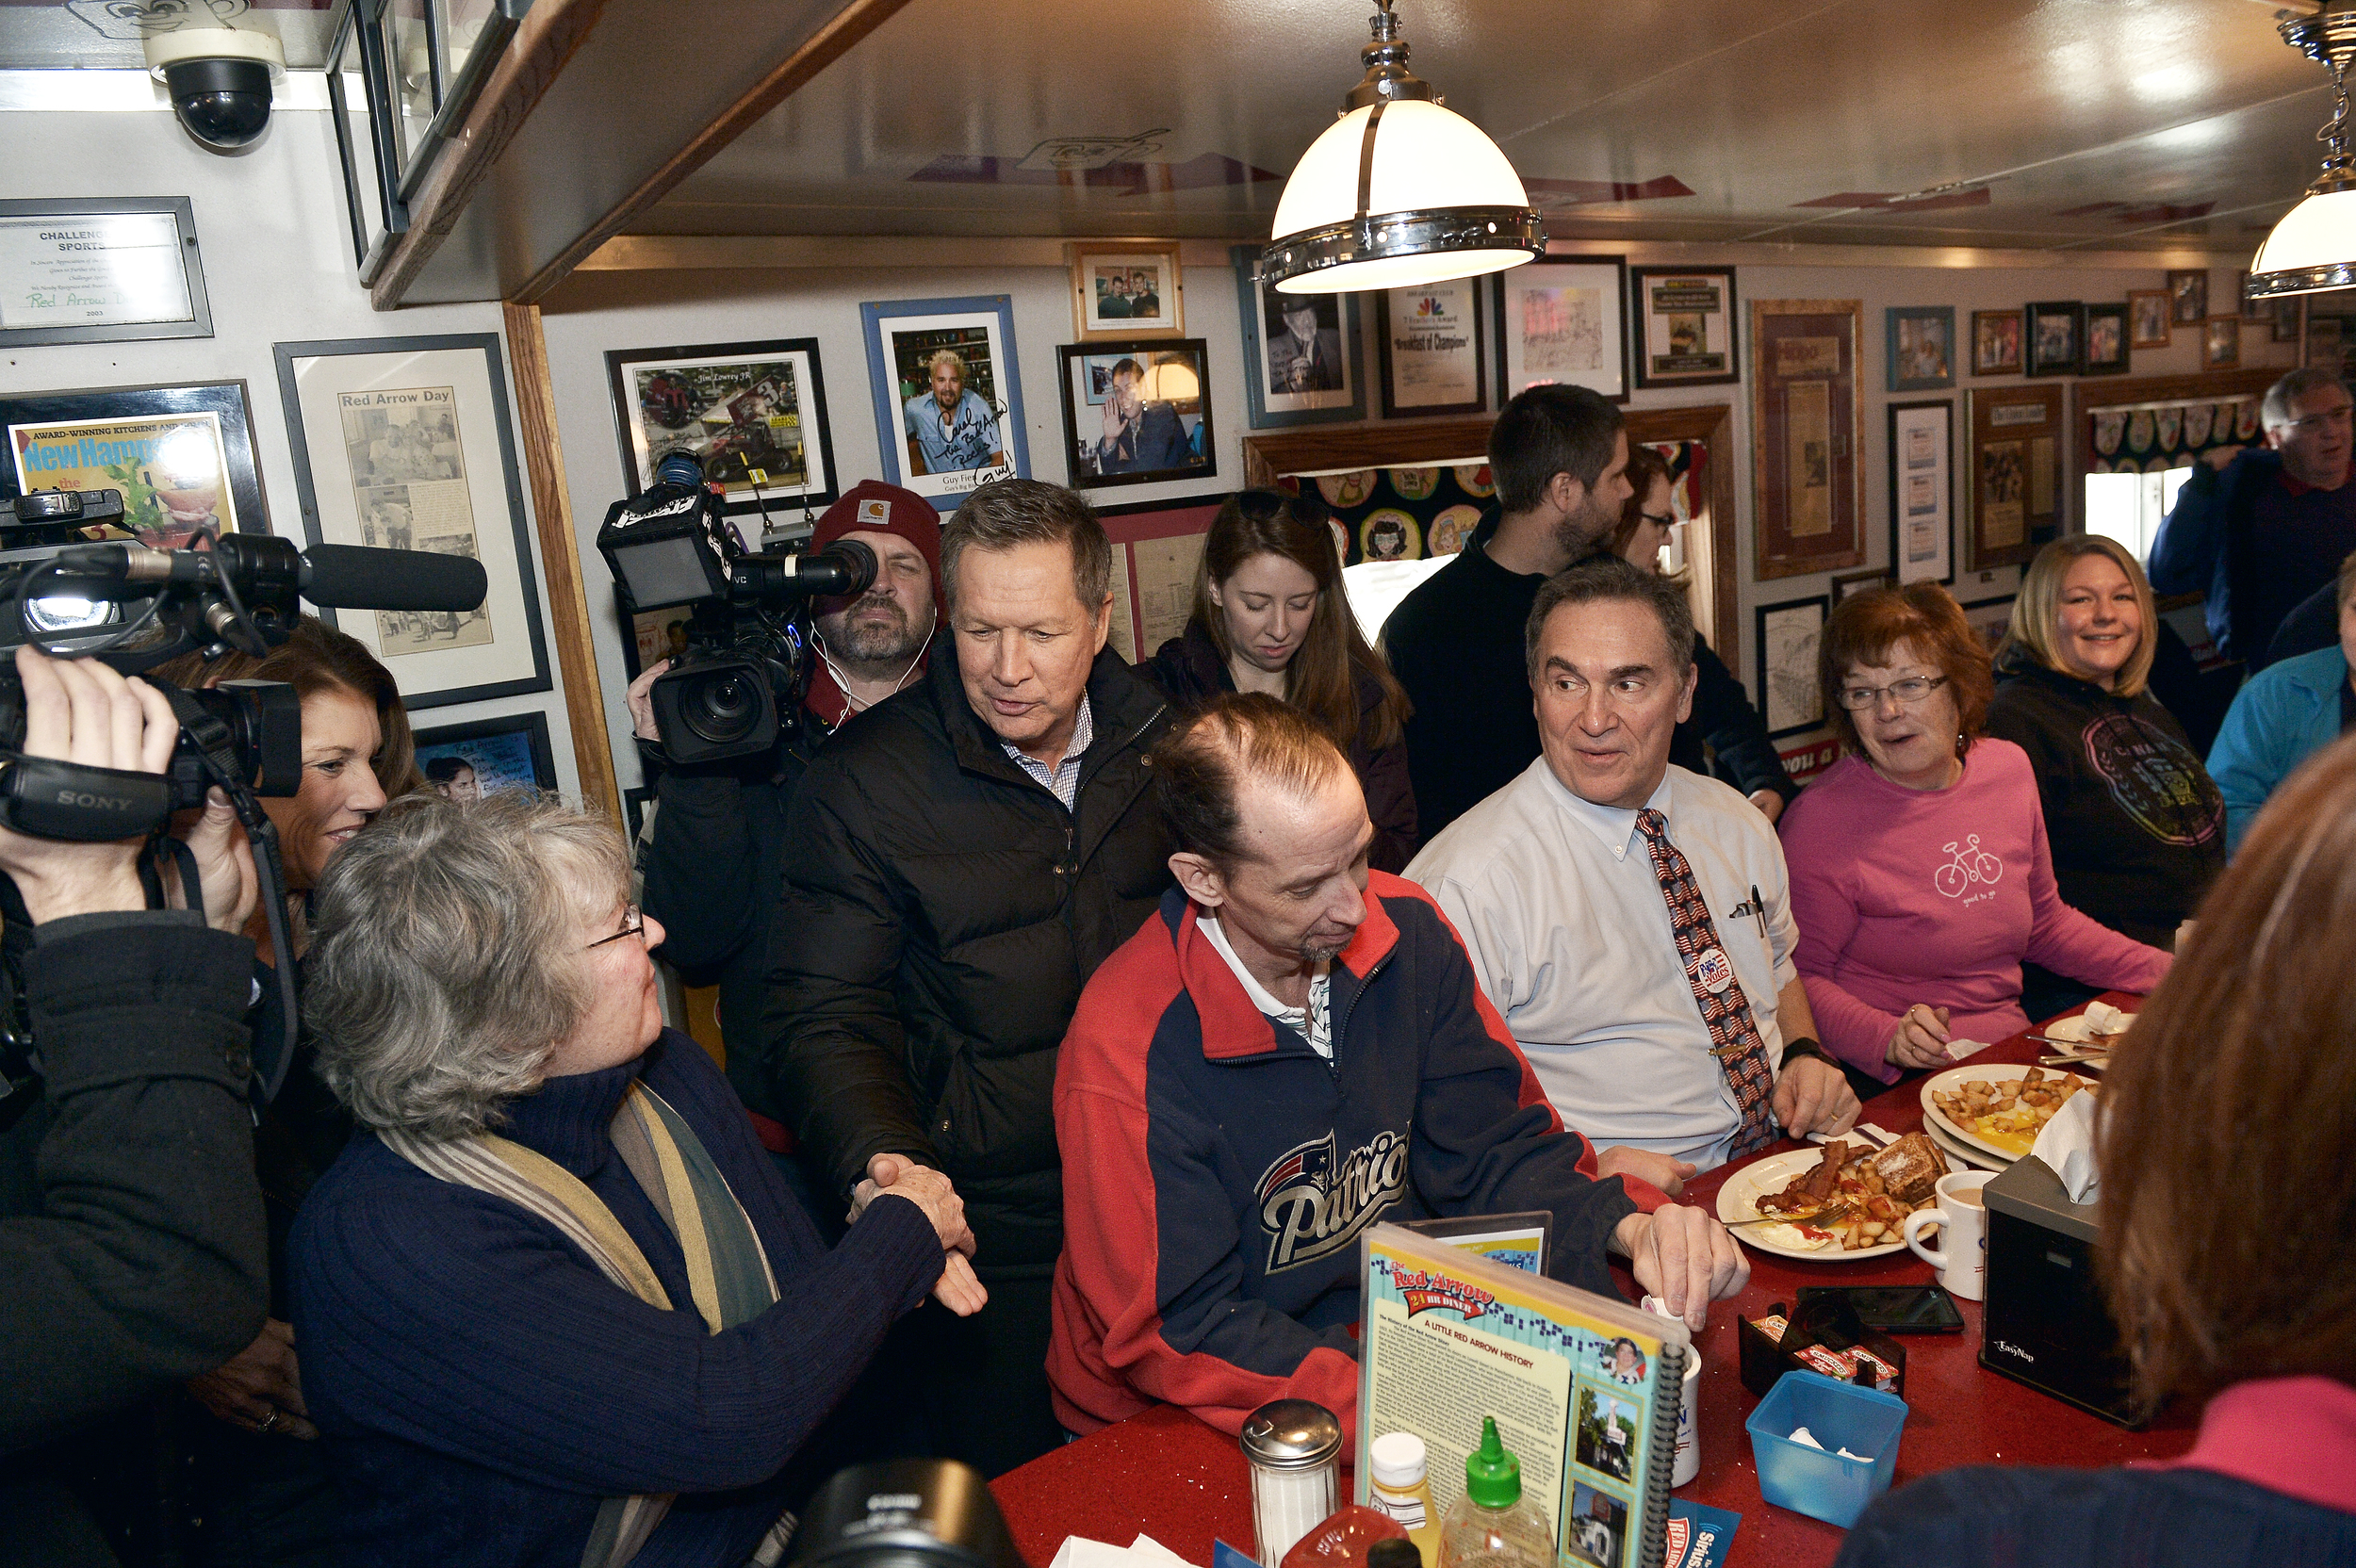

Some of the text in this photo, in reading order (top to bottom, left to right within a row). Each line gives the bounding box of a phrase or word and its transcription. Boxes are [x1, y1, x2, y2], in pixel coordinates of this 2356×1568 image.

[40, 231, 111, 240] CHALLENGE
[58, 242, 106, 252] SPORTS
[26, 292, 56, 308] Red
[67, 292, 106, 306] Arrow
[342, 390, 450, 407] Red Arrow Day
[757, 381, 780, 407] 3
[33, 427, 112, 440] AWARD-WINNING
[113, 424, 157, 433] KITCHENS
[159, 422, 179, 431] AND
[58, 477, 81, 488] the
[942, 476, 959, 484] Guy
[57, 790, 133, 810] SONY
[1706, 966, 1729, 984] Votes
[1263, 1137, 1408, 1265] Patrio
[1390, 1261, 1405, 1269] The
[1393, 1270, 1495, 1304] Red Arrow
[1411, 1293, 1472, 1314] 24 HR DINER
[1424, 1319, 1533, 1369] A LITTLE RED ARROW HISTORY
[2000, 1340, 2035, 1364] EasyNap
[1667, 1521, 1686, 1549] RED
[1687, 1531, 1715, 1568] Sirius
